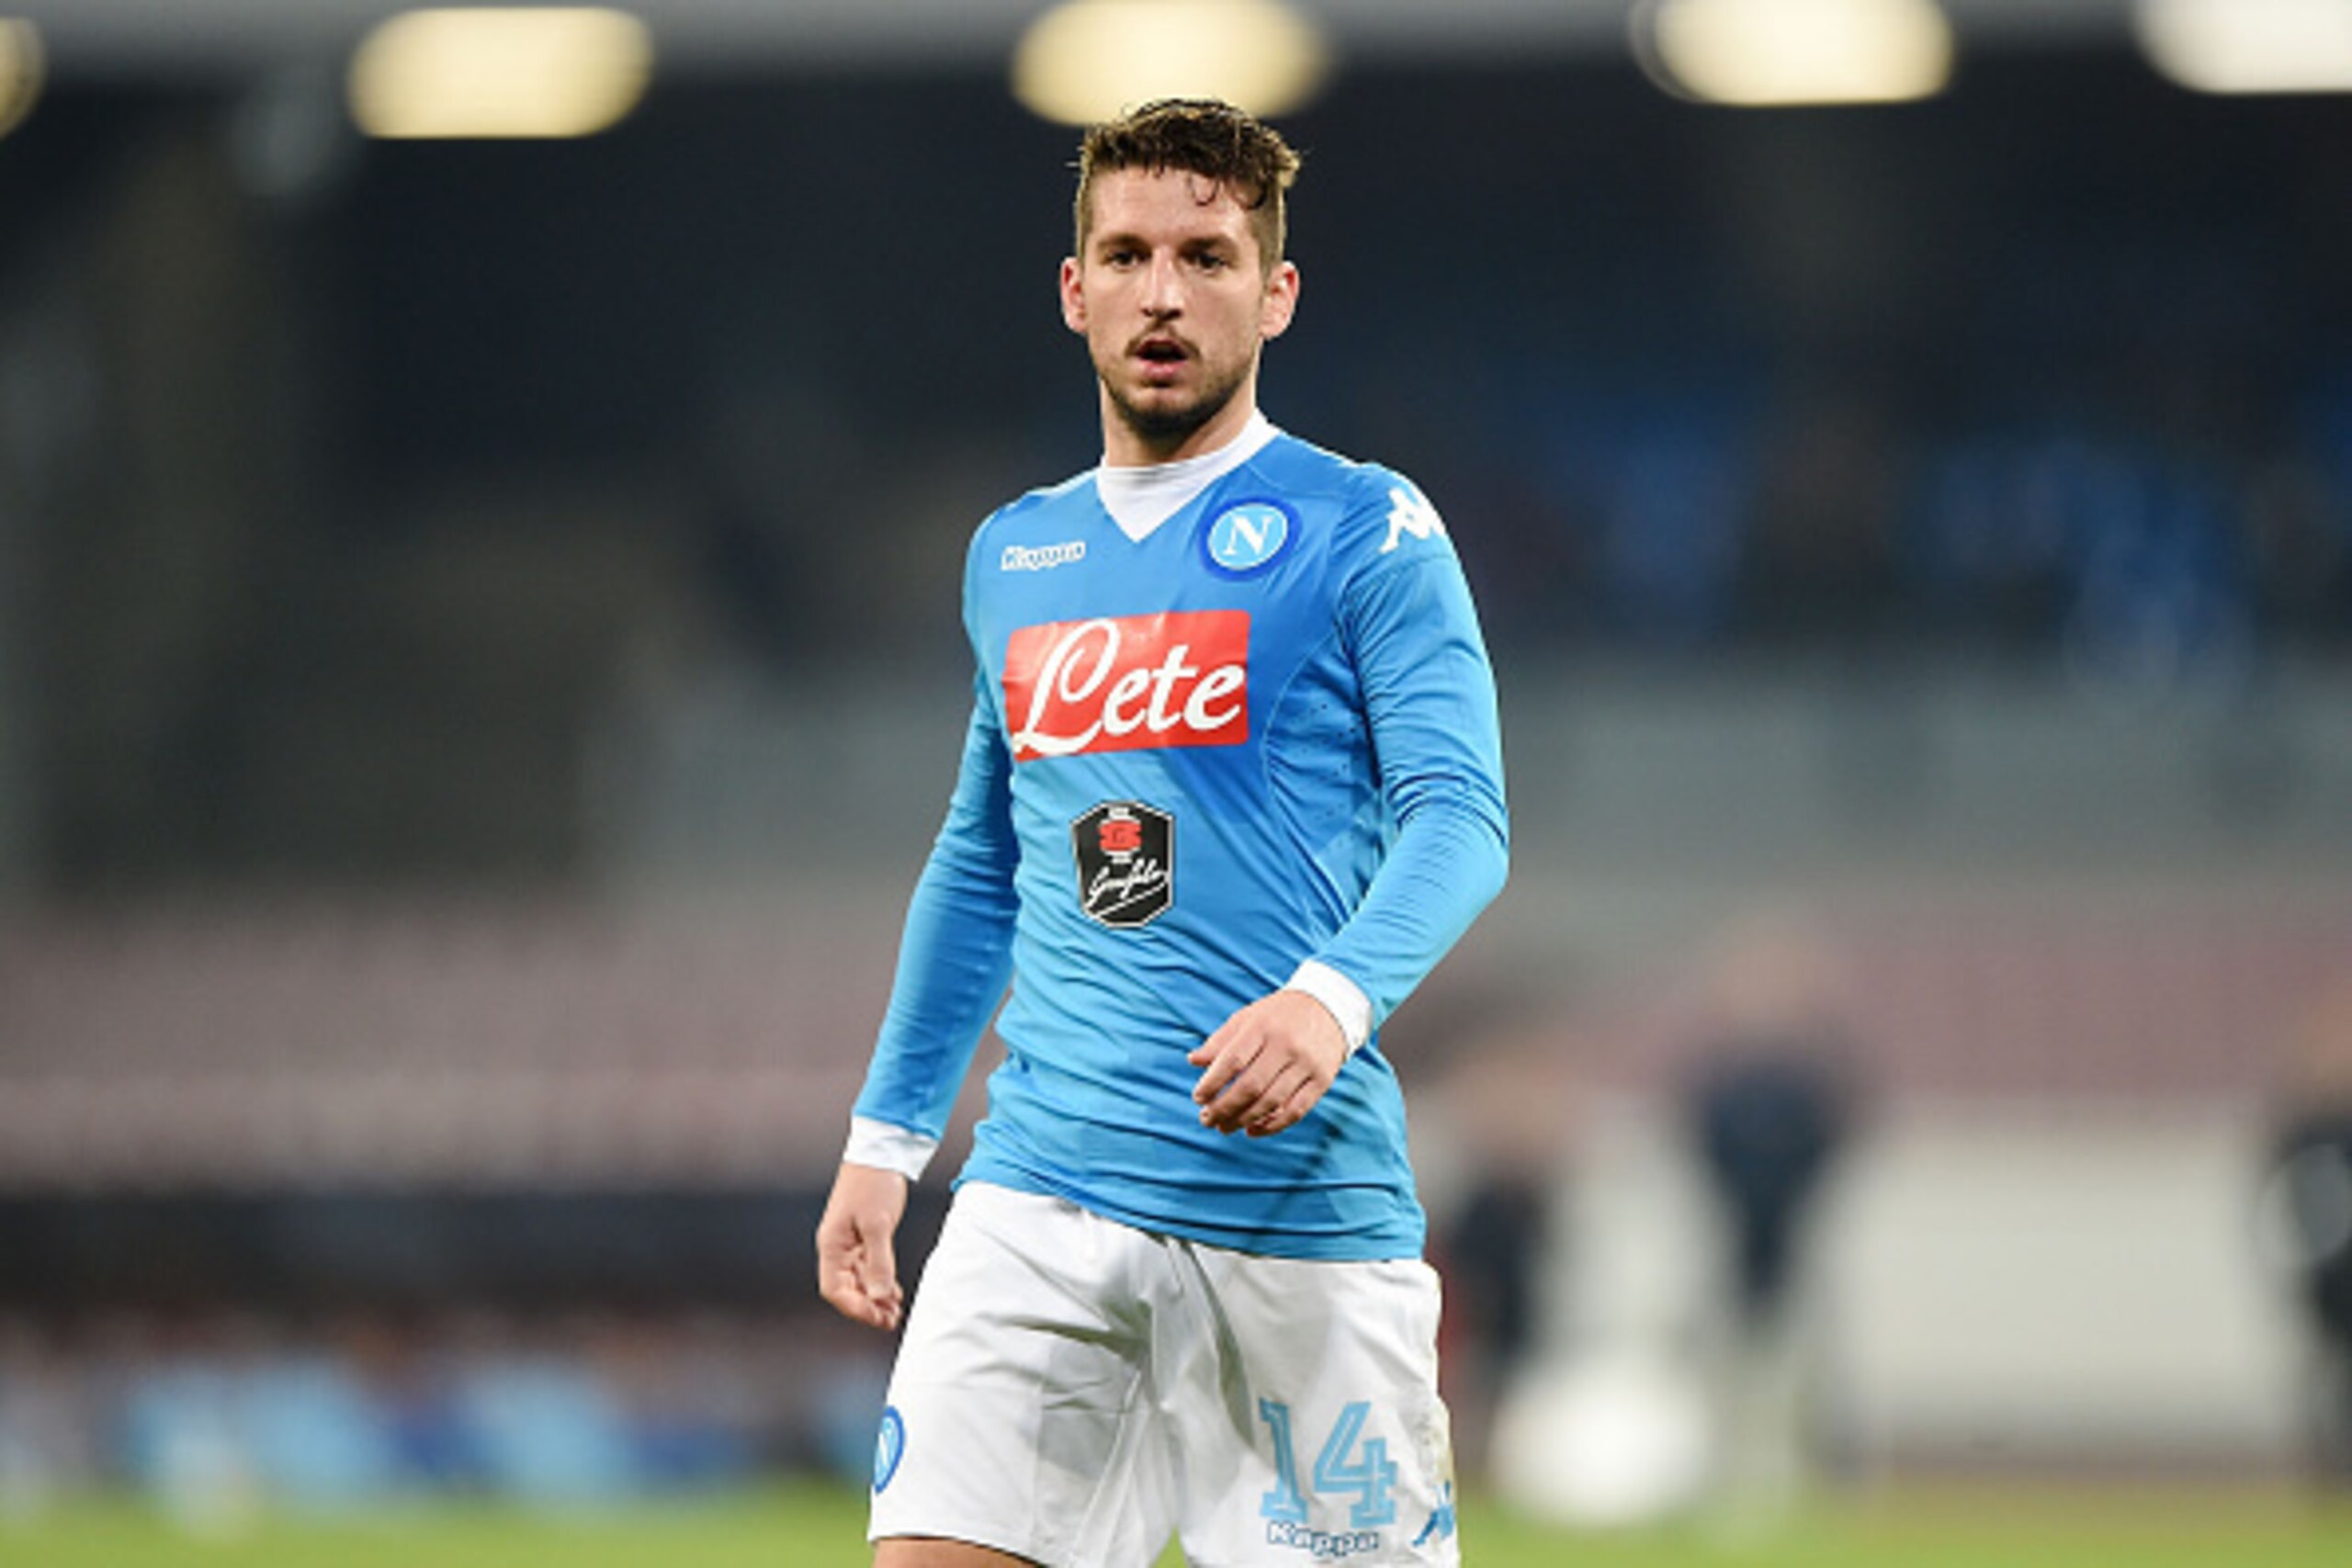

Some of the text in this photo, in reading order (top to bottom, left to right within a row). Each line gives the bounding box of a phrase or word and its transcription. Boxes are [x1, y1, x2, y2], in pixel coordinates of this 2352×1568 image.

[1223, 514, 1273, 556] N
[1012, 618, 1244, 756] Lete
[1259, 1397, 1397, 1528] 14
[1267, 1519, 1379, 1556] Kappa
